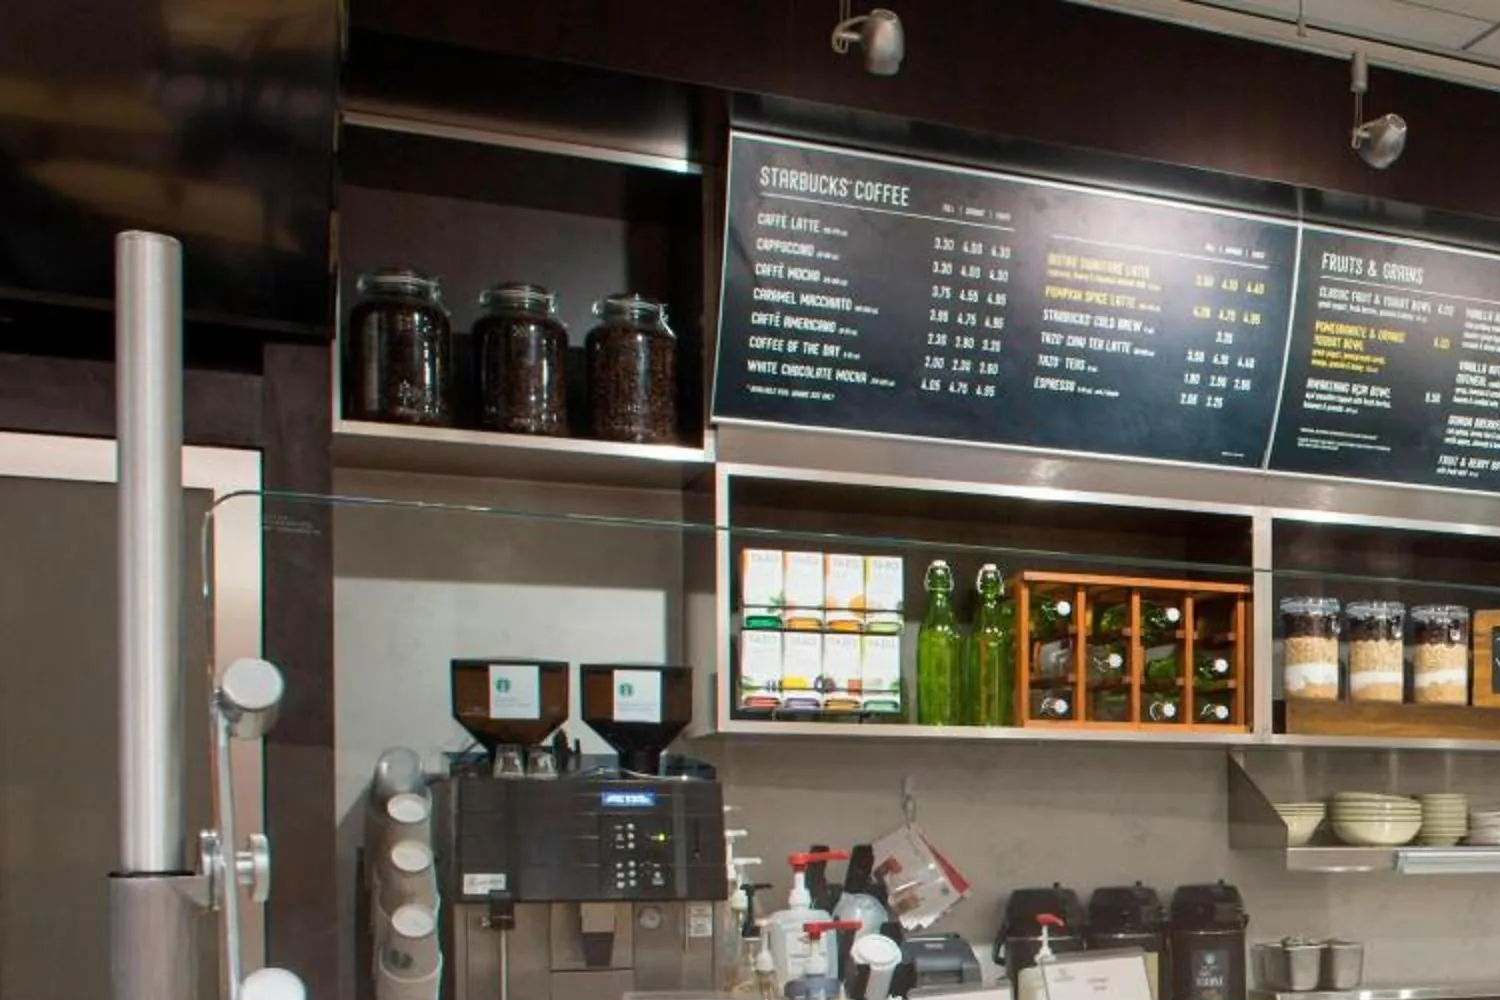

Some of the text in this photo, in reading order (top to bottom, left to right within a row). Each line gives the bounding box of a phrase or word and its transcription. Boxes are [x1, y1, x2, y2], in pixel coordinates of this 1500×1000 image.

[854, 180, 909, 206] COFFEE
[791, 215, 820, 233] LATTE
[787, 267, 821, 283] MOCHA
[1321, 252, 1425, 285] FRUITS & GRAINS
[752, 287, 797, 305] CARAMEL
[1110, 295, 1137, 309] LATTE
[783, 315, 837, 333] AMERICANO
[1117, 317, 1143, 332] BREW
[748, 335, 842, 358] COFFEE OF THE DAY
[1105, 340, 1132, 355] LATTE
[747, 359, 868, 384] WHITE CHOCOLATE MOCHA
[1033, 376, 1077, 393] ESPRESSO
